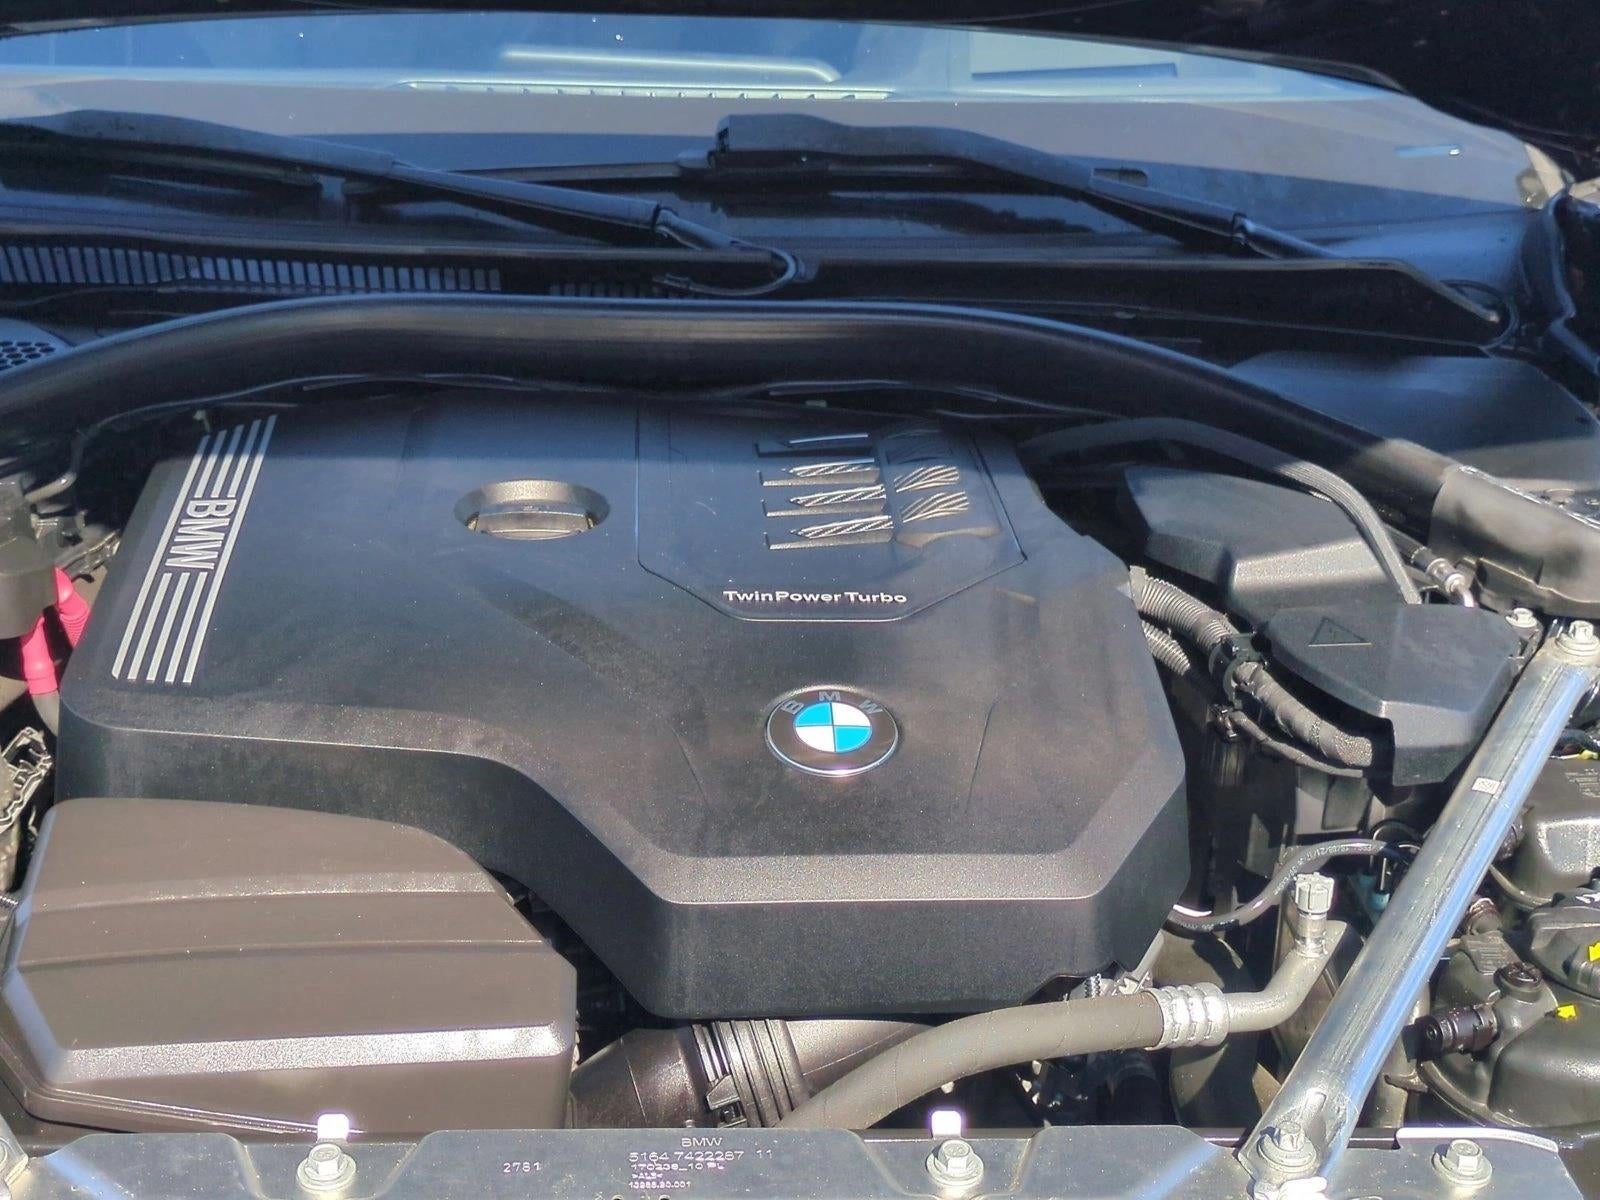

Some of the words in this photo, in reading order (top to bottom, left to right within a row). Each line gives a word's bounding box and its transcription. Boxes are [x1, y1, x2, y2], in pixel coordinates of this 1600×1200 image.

[165, 499, 237, 569] BMW
[844, 592, 907, 603] Turbo
[780, 691, 883, 714] BMW
[681, 1137, 723, 1147] BMW
[629, 1152, 670, 1162] 5164
[503, 1161, 541, 1173] 2781
